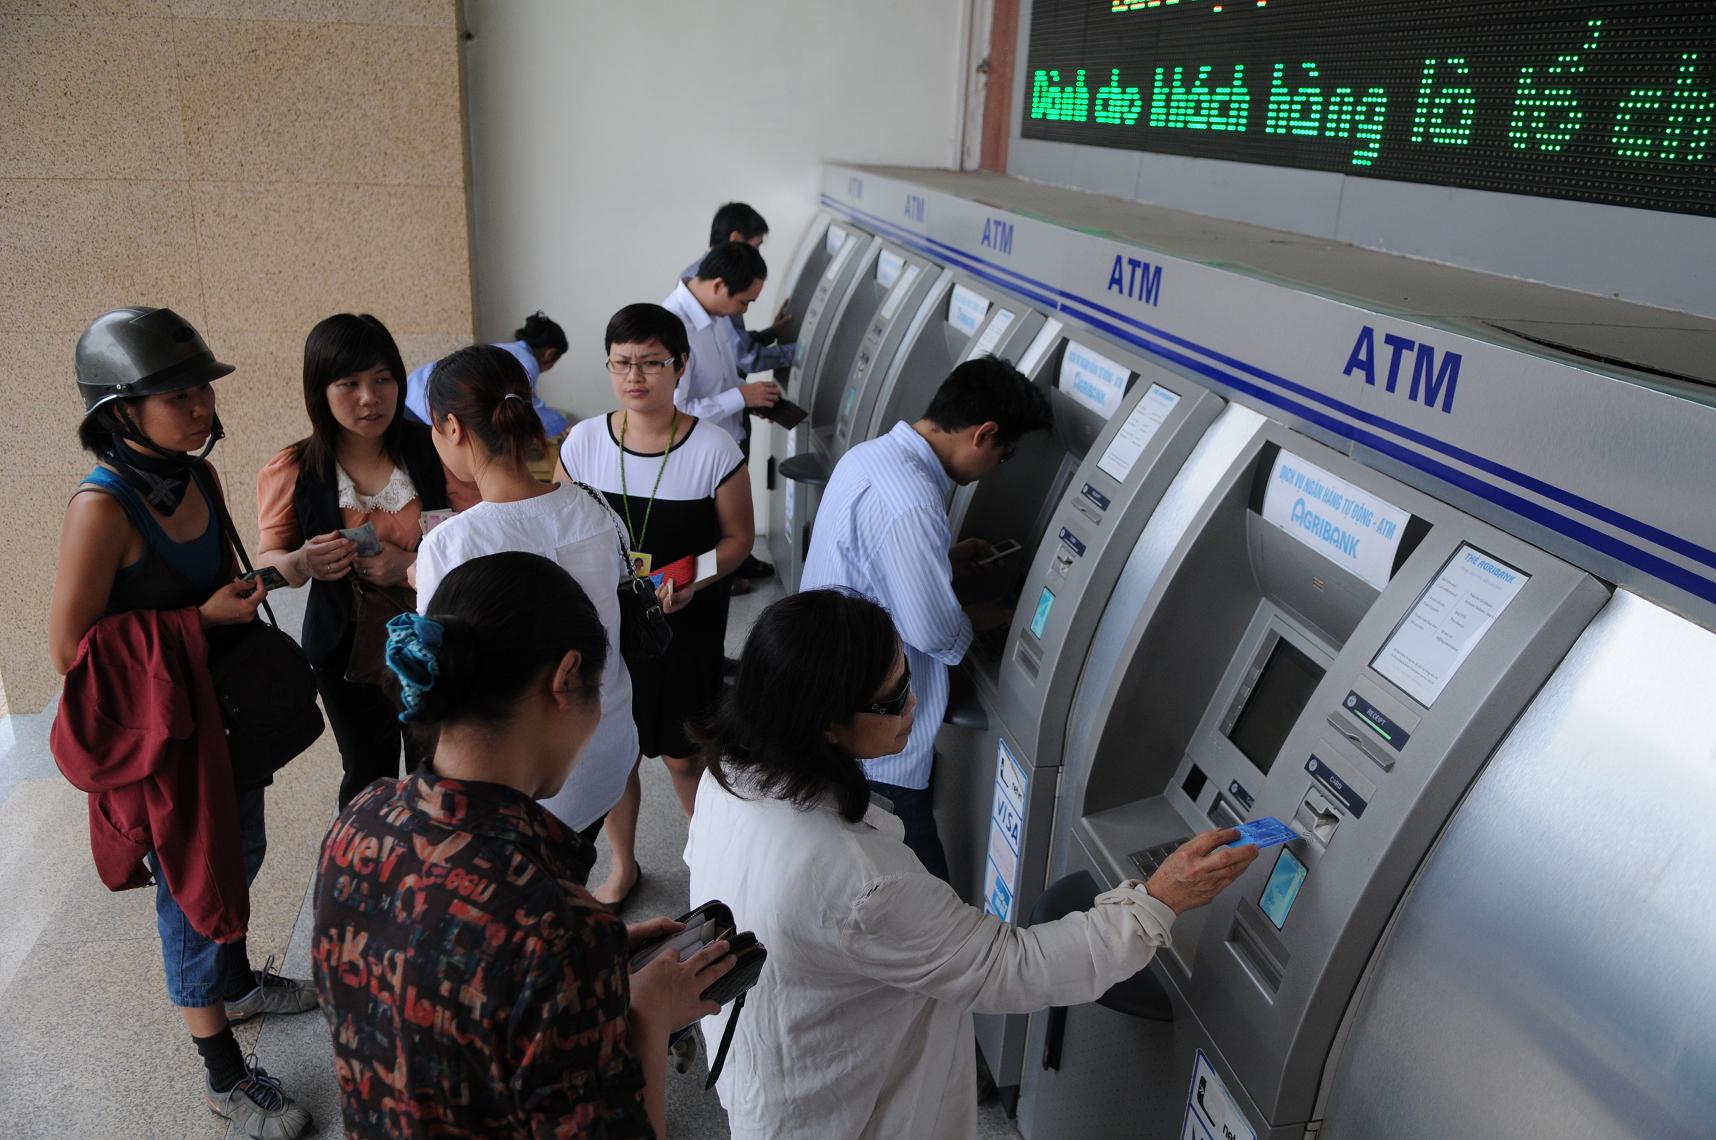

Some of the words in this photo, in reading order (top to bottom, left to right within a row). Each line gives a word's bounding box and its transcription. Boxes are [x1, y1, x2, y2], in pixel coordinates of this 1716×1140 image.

[904, 194, 925, 223] ATM
[980, 217, 1014, 256] ATM
[1108, 254, 1163, 307] ATM
[1343, 325, 1463, 414] ATM
[1291, 497, 1360, 559] AGRIBANK
[1375, 516, 1398, 541] ATM
[1366, 708, 1387, 727] RECEIPT
[1329, 776, 1343, 790] CARD
[997, 796, 1020, 846] VISA
